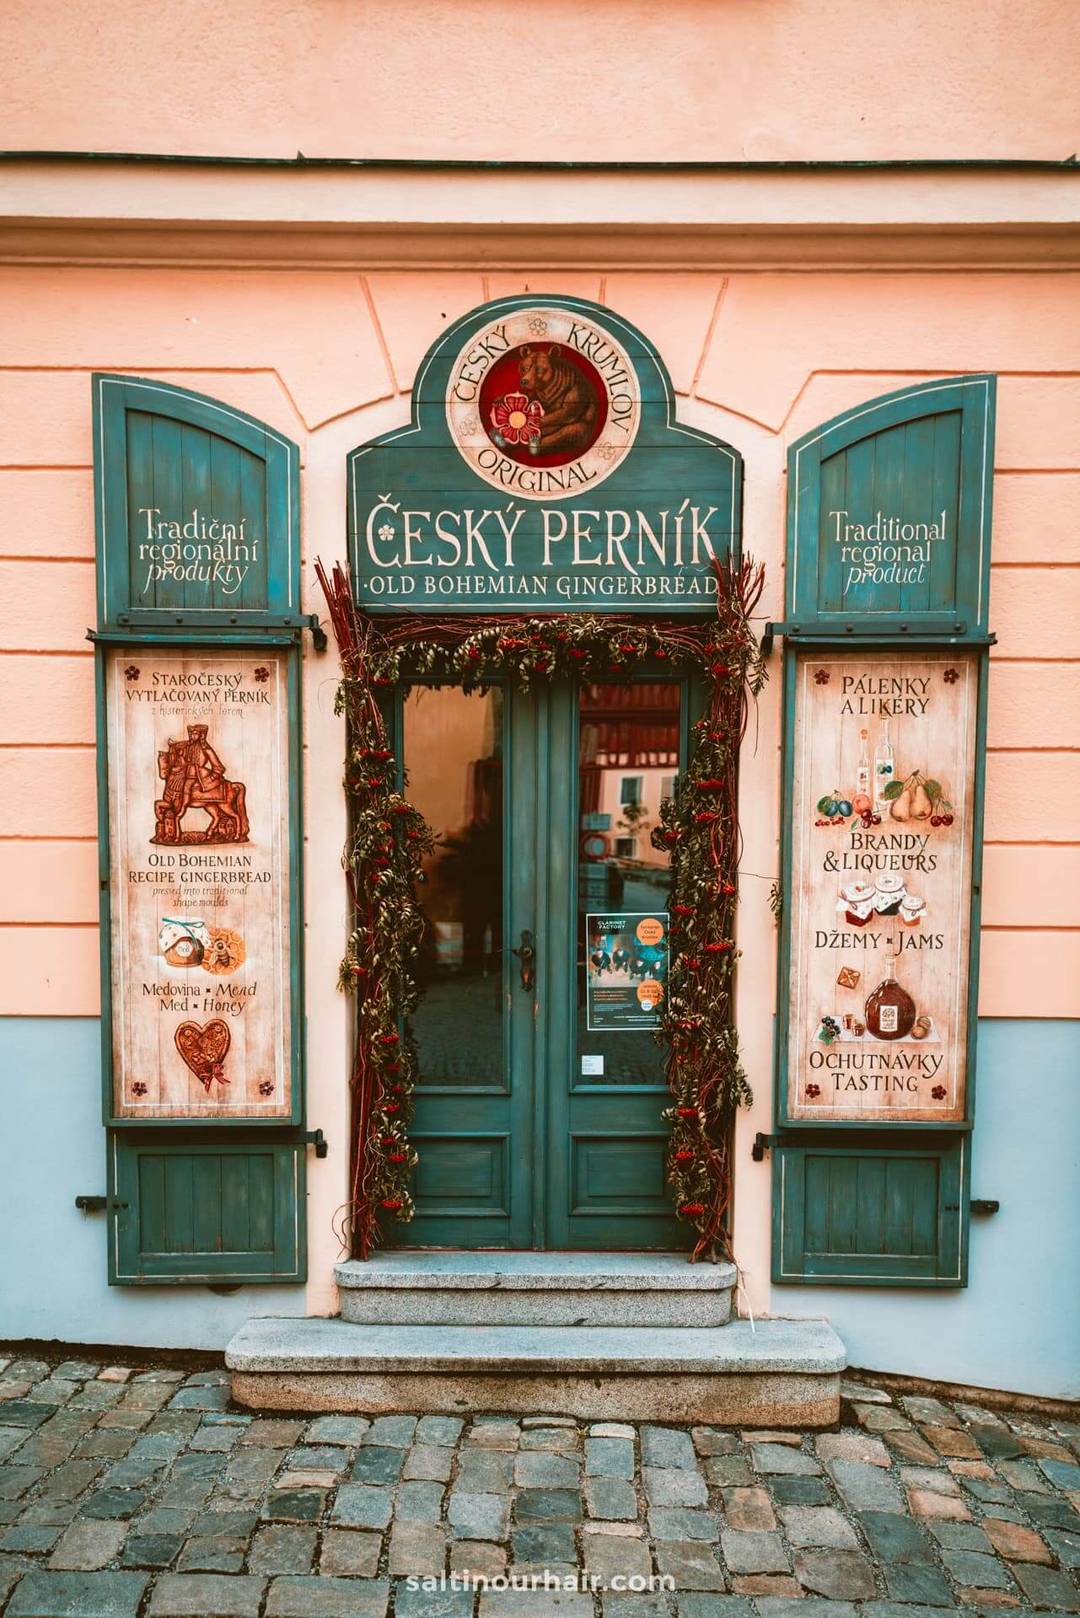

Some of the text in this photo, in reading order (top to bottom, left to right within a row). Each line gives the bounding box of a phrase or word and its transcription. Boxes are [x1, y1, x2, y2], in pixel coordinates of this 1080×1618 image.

[453, 323, 631, 434] ČESKÝ KRUMLOV
[477, 448, 598, 493] ORIGINAL
[138, 508, 246, 540] Tradiční
[365, 493, 719, 575] ČESKÝ PERNÍK
[828, 509, 946, 541] Traditional
[139, 530, 259, 569] regionální
[841, 540, 931, 572] regional
[143, 559, 249, 594] produkty
[424, 576, 547, 594] BOHEMIAN
[556, 575, 719, 599] GINGERBREAD
[843, 562, 926, 595] product
[152, 672, 243, 691] STAROČESKÝ
[842, 673, 931, 697] PÁLENKY
[126, 688, 271, 705] VYTLAČOVANÝ PERNÍK
[859, 694, 930, 718] LIKÉRY
[850, 832, 931, 859] BRANDY
[148, 854, 251, 867] OLD BOHEMIAN
[129, 871, 271, 884] RECIPE GINGERBREAD
[815, 929, 944, 956] DŽEMY JAMS
[142, 981, 257, 997] Medovina Mead
[160, 998, 246, 1016] Med Honey
[809, 1050, 944, 1079] OCHUTNÁVKY
[831, 1072, 918, 1092] TASTING
